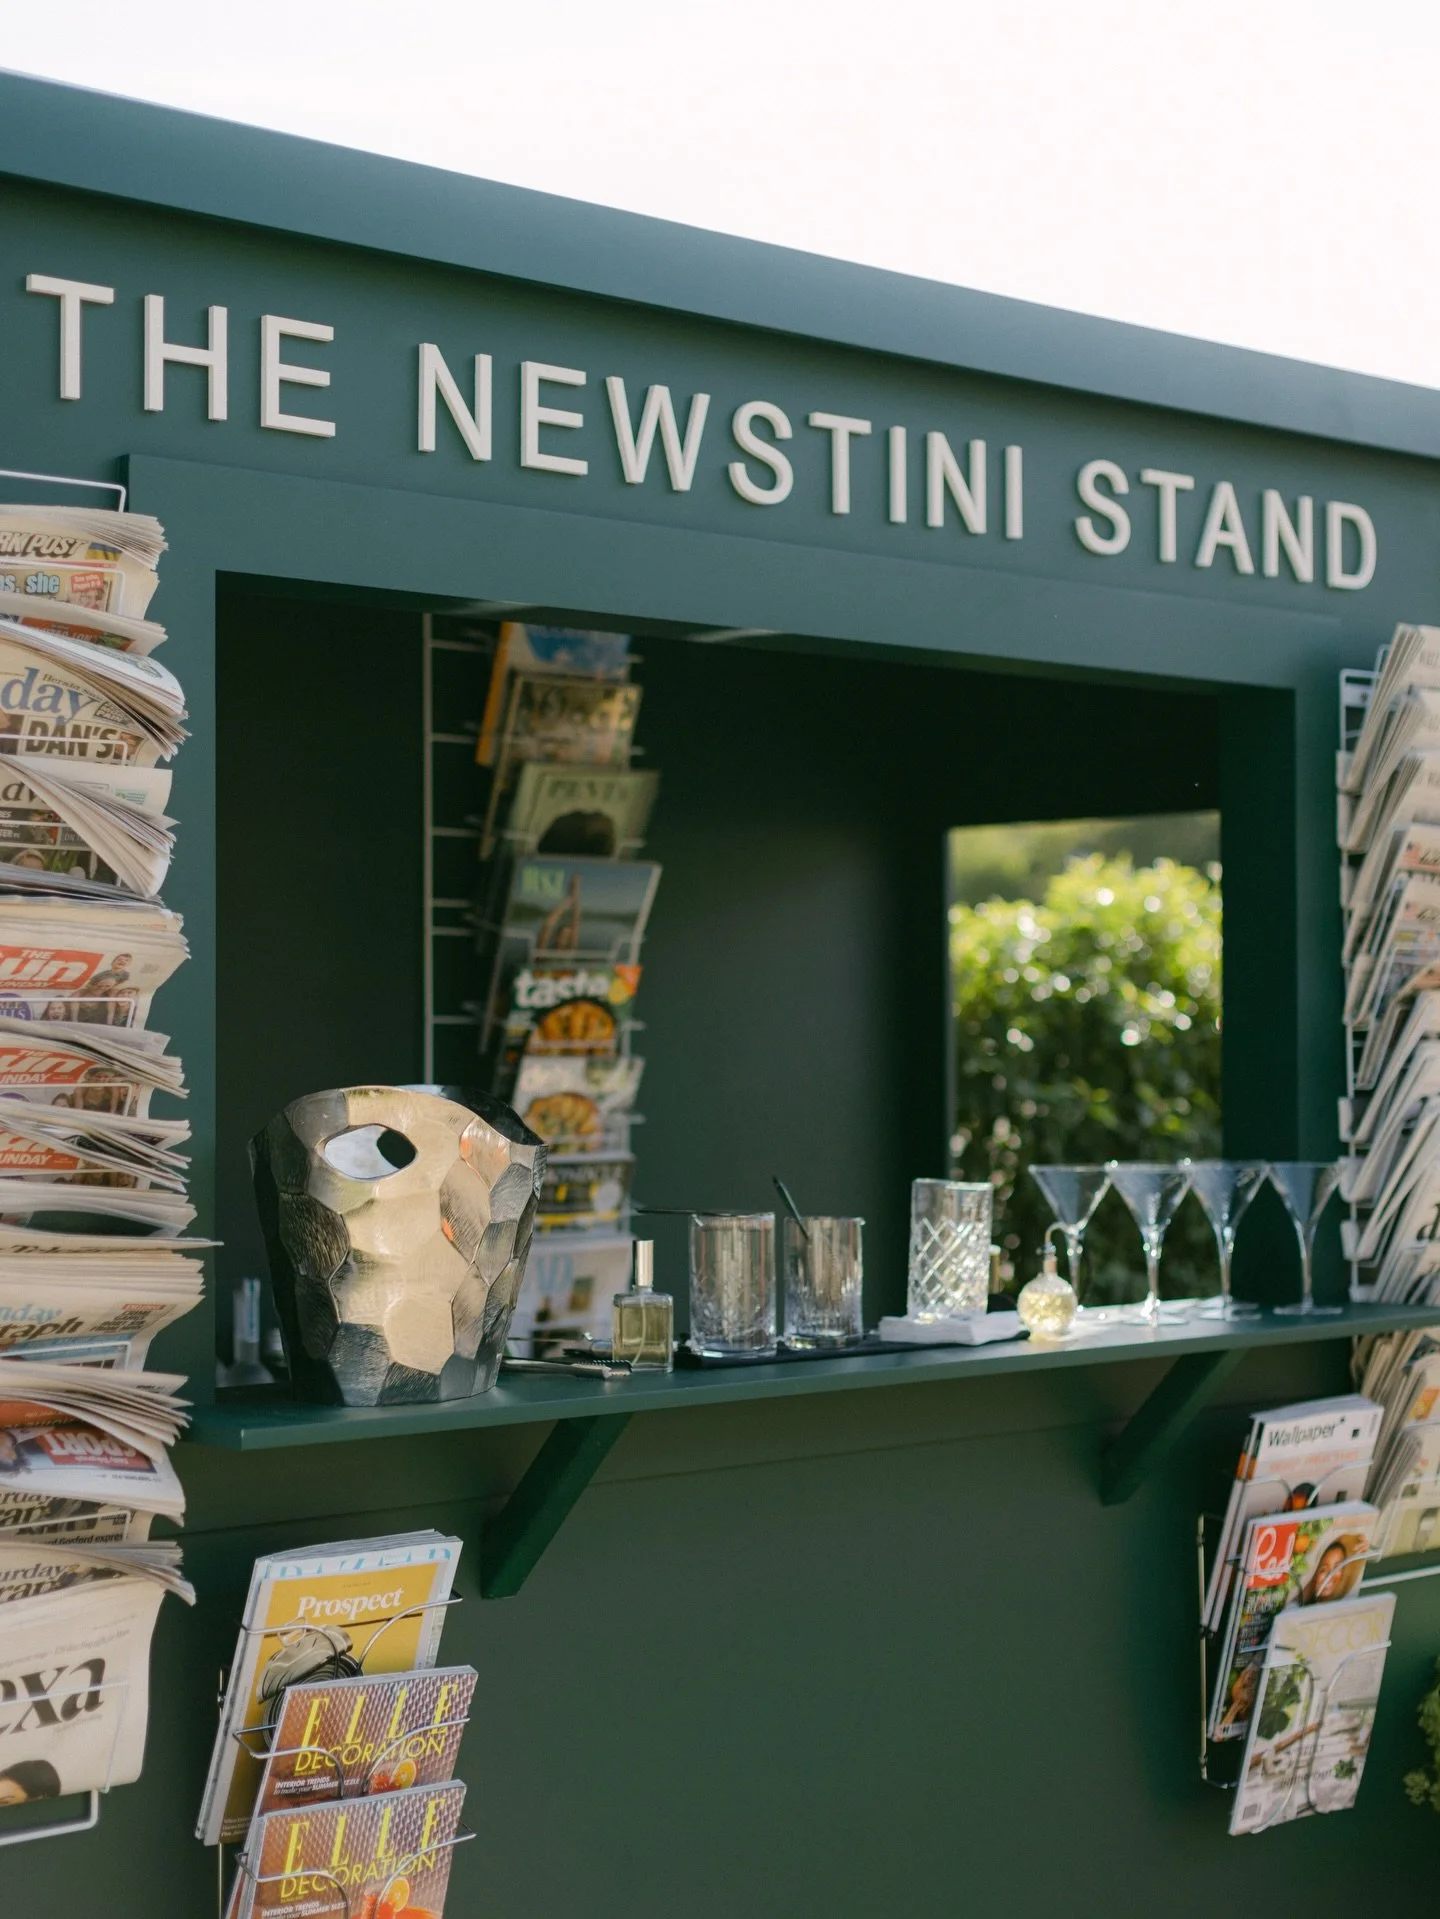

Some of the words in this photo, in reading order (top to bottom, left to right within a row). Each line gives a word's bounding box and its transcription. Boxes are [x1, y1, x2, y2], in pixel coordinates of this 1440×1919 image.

[26, 274, 337, 438] THE
[417, 342, 1024, 540] NEWSTINI
[1074, 459, 1378, 591] STAND
[26, 533, 88, 559] POST
[24, 571, 61, 595] she
[1, 666, 99, 726] day
[25, 720, 118, 759] DAN'S
[1249, 1526, 1296, 1586] Red
[297, 1586, 405, 1621] Prospect
[300, 1684, 459, 1749] ELLE
[294, 1735, 446, 1773] DECORATION
[275, 1779, 306, 1788] INTERIOR
[282, 1797, 446, 1875] ELLE
[280, 1852, 438, 1898] DECORATION
